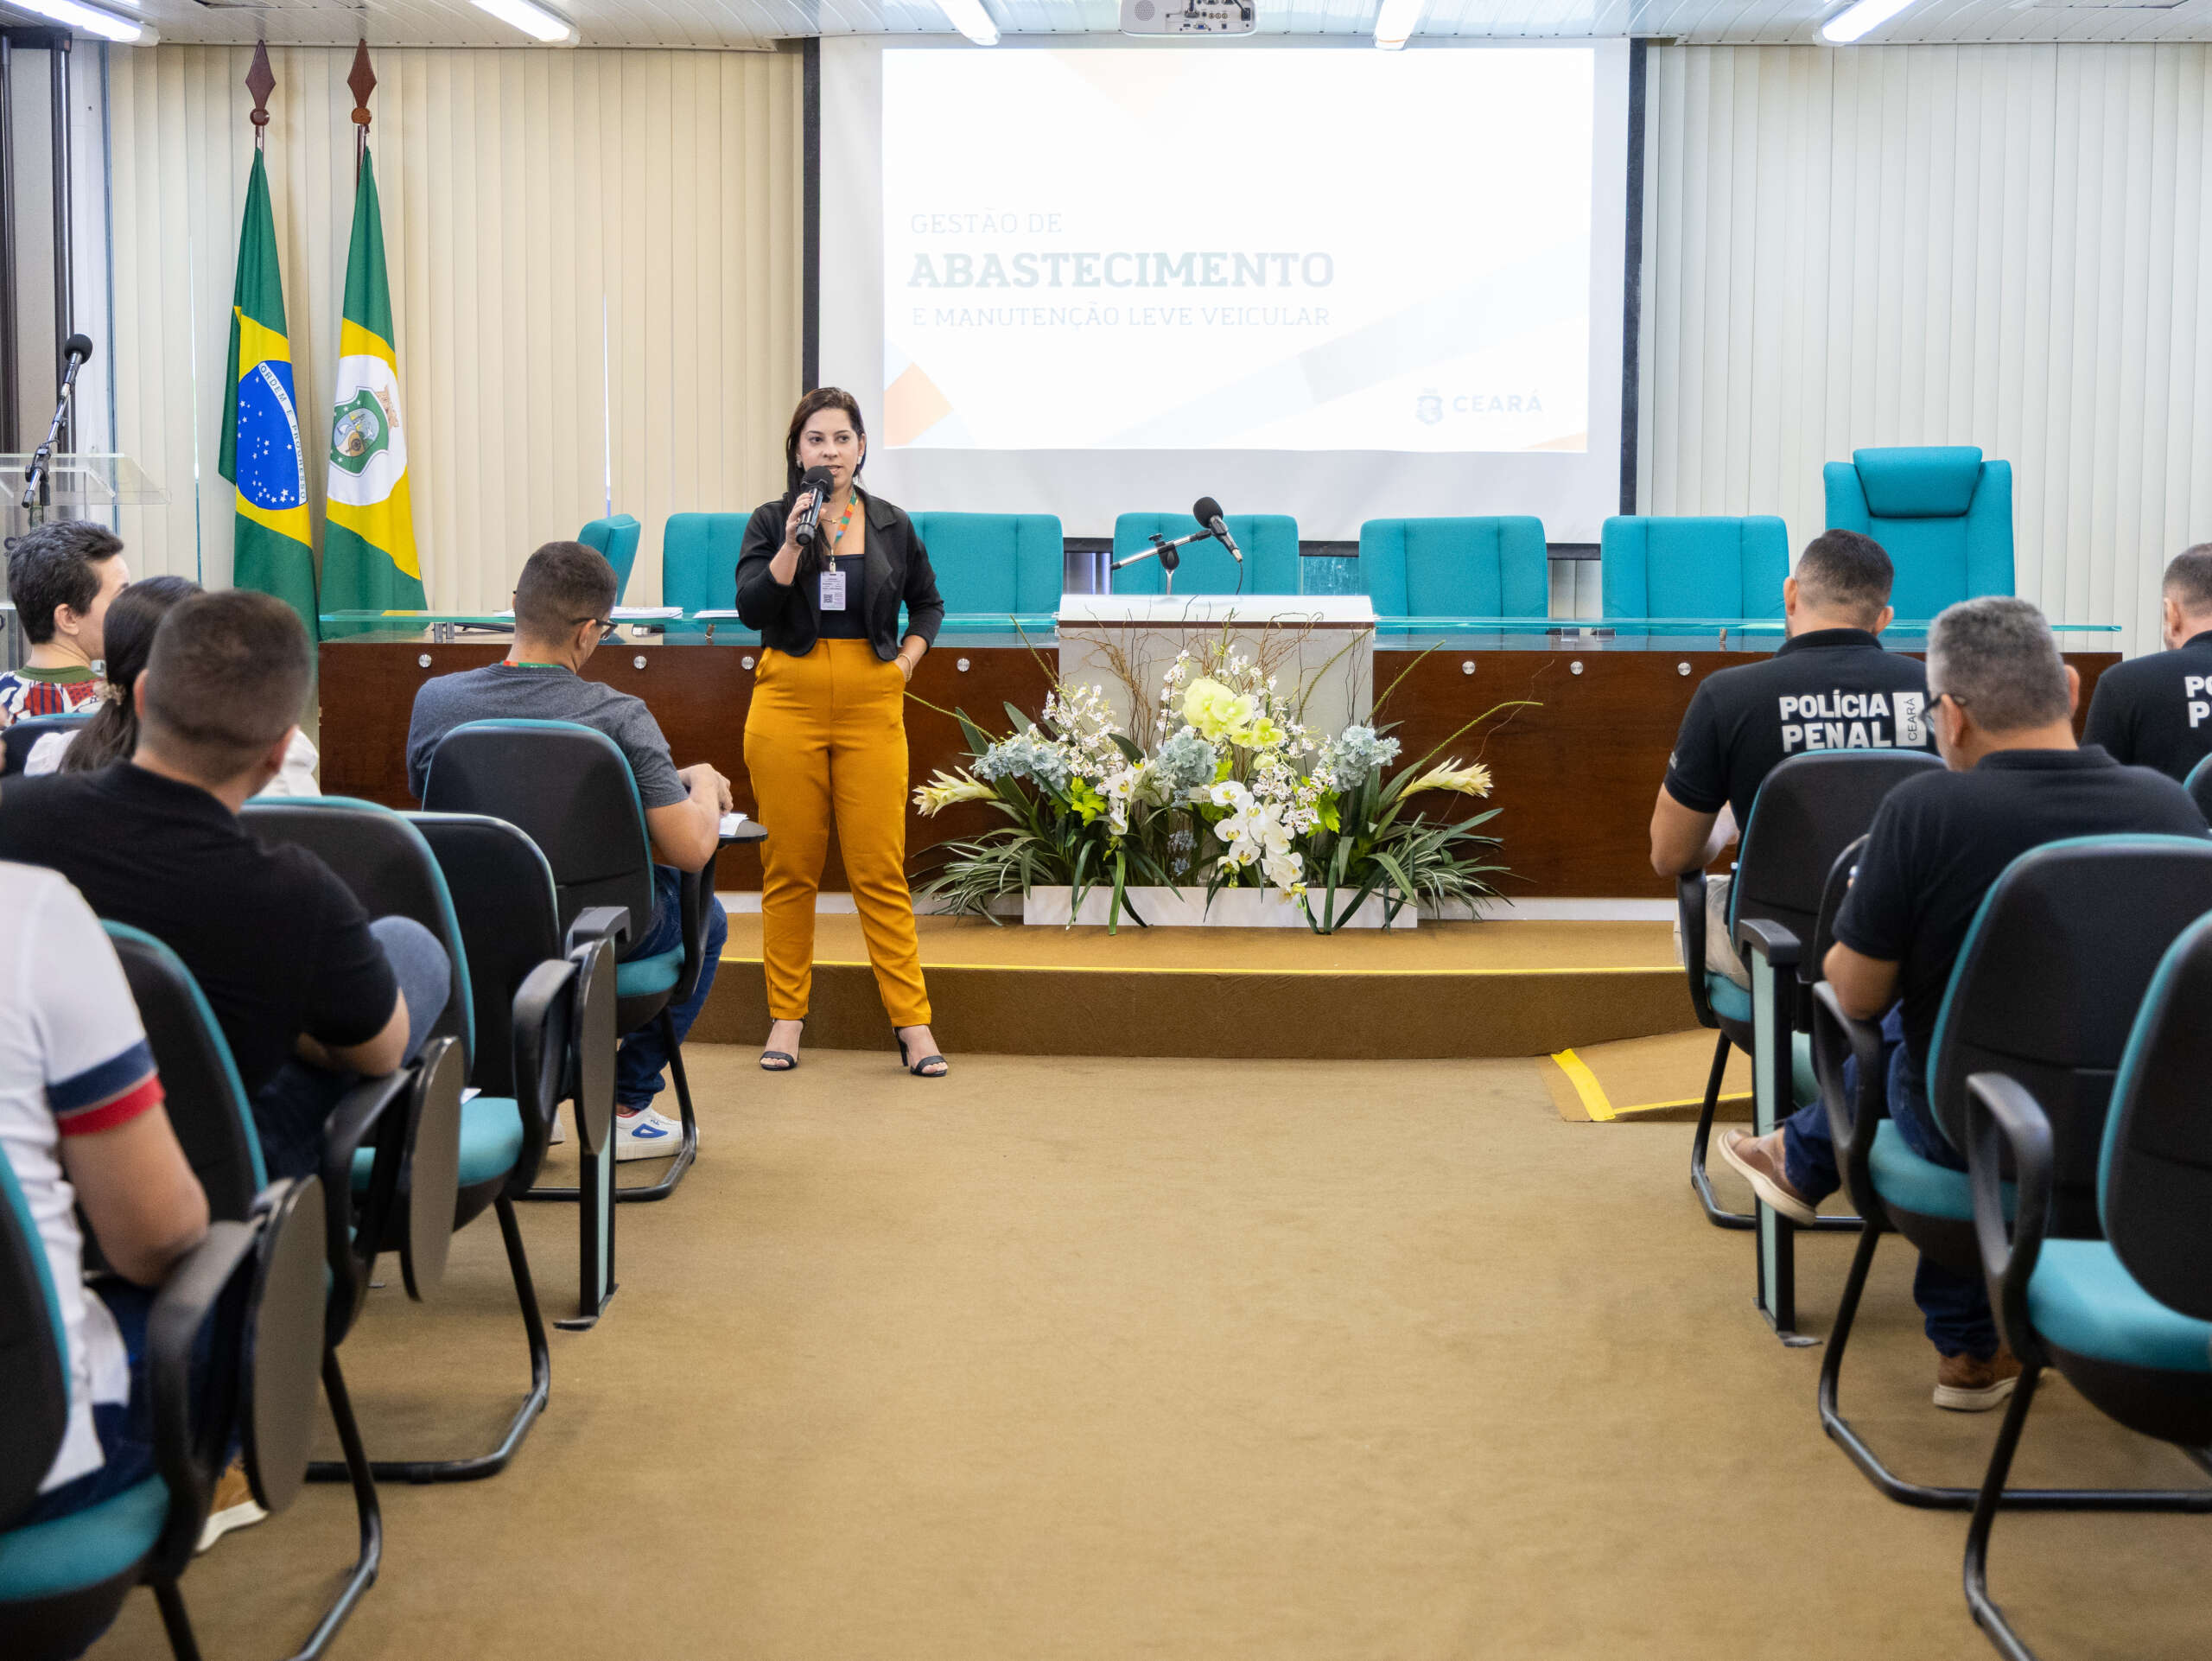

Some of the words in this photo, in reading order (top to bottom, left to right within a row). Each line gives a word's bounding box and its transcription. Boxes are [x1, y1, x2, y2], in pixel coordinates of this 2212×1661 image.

[912, 207, 1019, 234] GESTÃO
[1028, 213, 1063, 234] DE
[907, 251, 1335, 288] ABASTECIMENTO
[912, 307, 928, 326] E
[935, 301, 1120, 332] MANUTENÇÃO
[1128, 307, 1193, 326] LEVE
[1201, 307, 1331, 326] VEICULAR
[260, 365, 288, 402] ORDEM
[1452, 387, 1543, 413] CEARÁ
[1778, 689, 1891, 722] POLÍCIA
[1904, 697, 1917, 741] CEARÁ
[1781, 721, 1892, 753] PENAL
